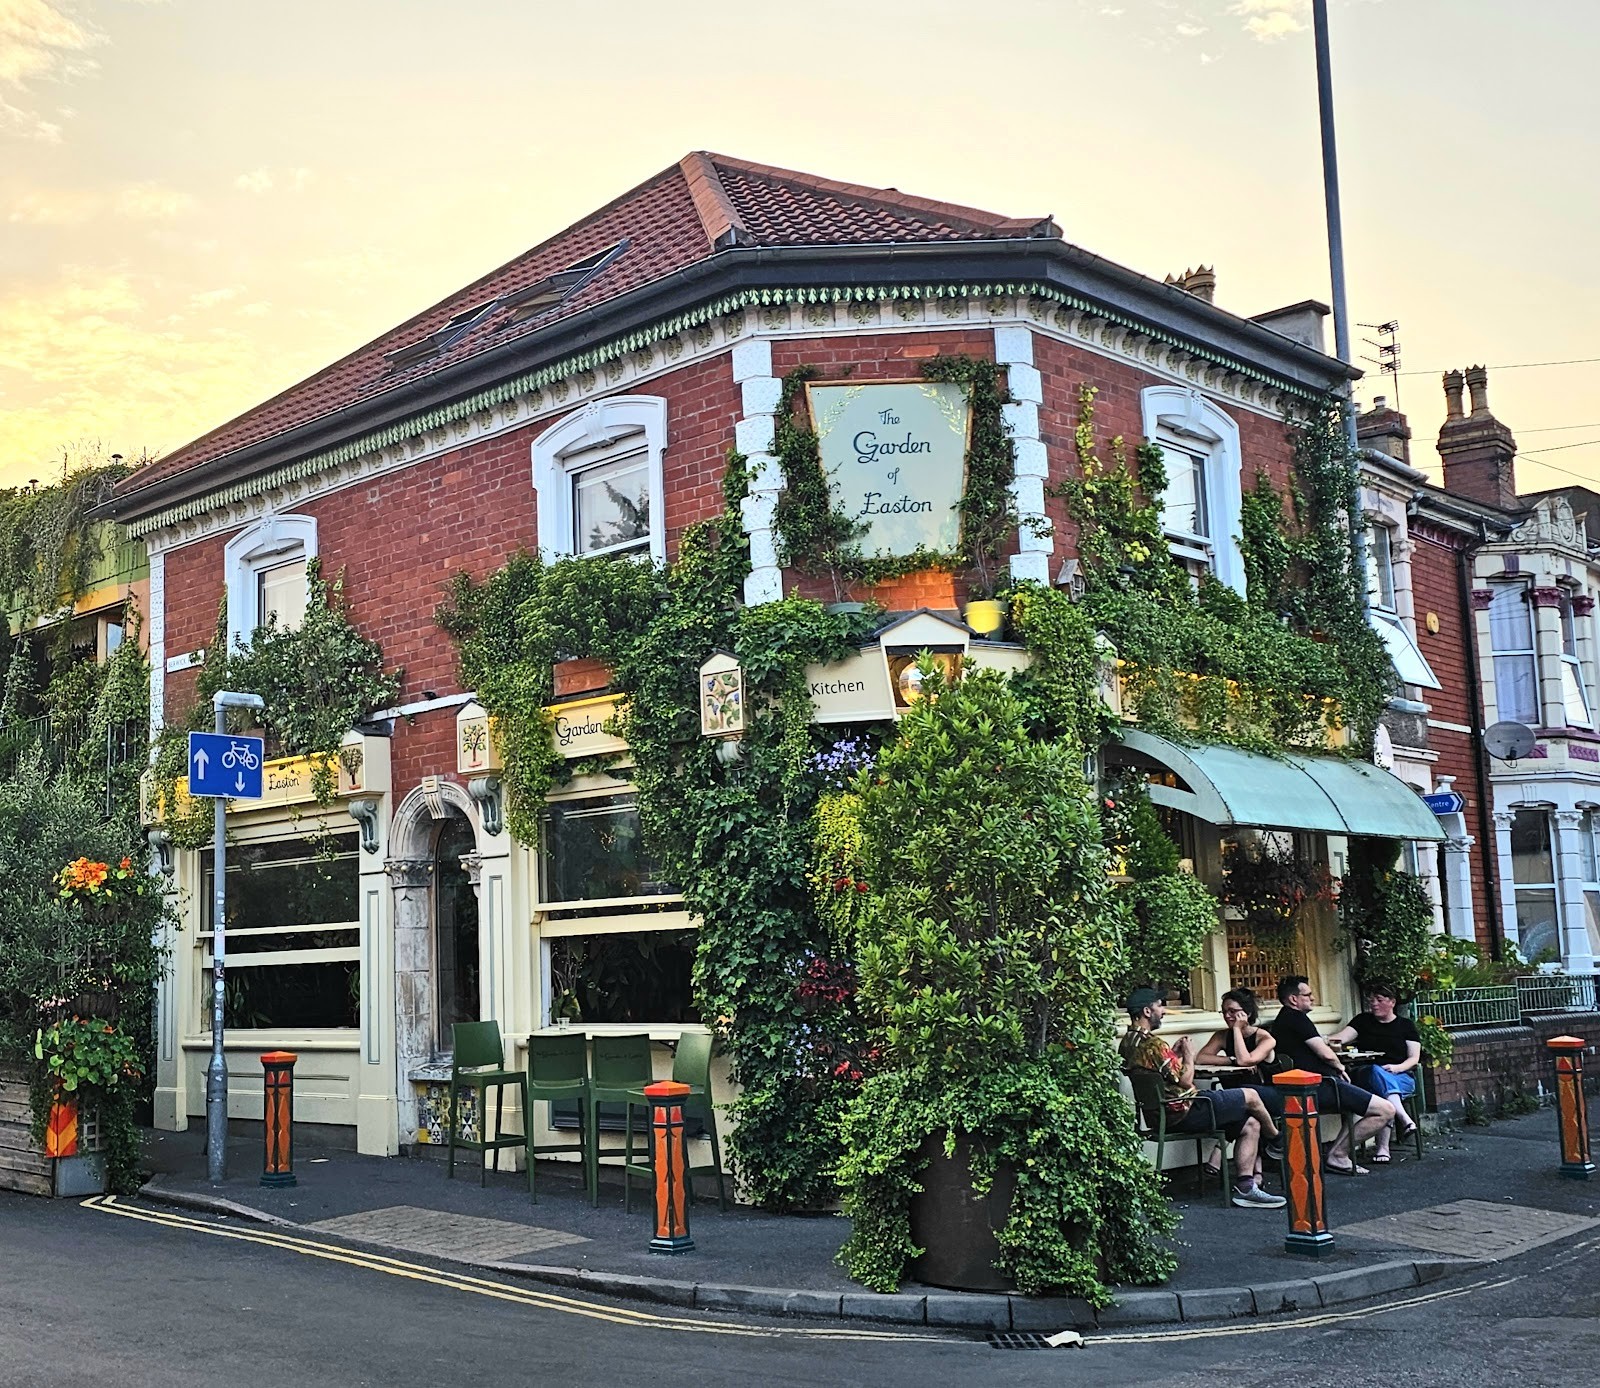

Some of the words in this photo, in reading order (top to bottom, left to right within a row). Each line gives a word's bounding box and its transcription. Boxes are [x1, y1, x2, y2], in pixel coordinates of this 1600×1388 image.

[878, 408, 900, 425] The
[853, 431, 931, 464] Garden
[887, 467, 900, 485] of
[860, 492, 932, 515] Easton
[811, 680, 865, 695] Kitchen
[555, 715, 605, 746] Garden
[268, 773, 300, 790] Easton
